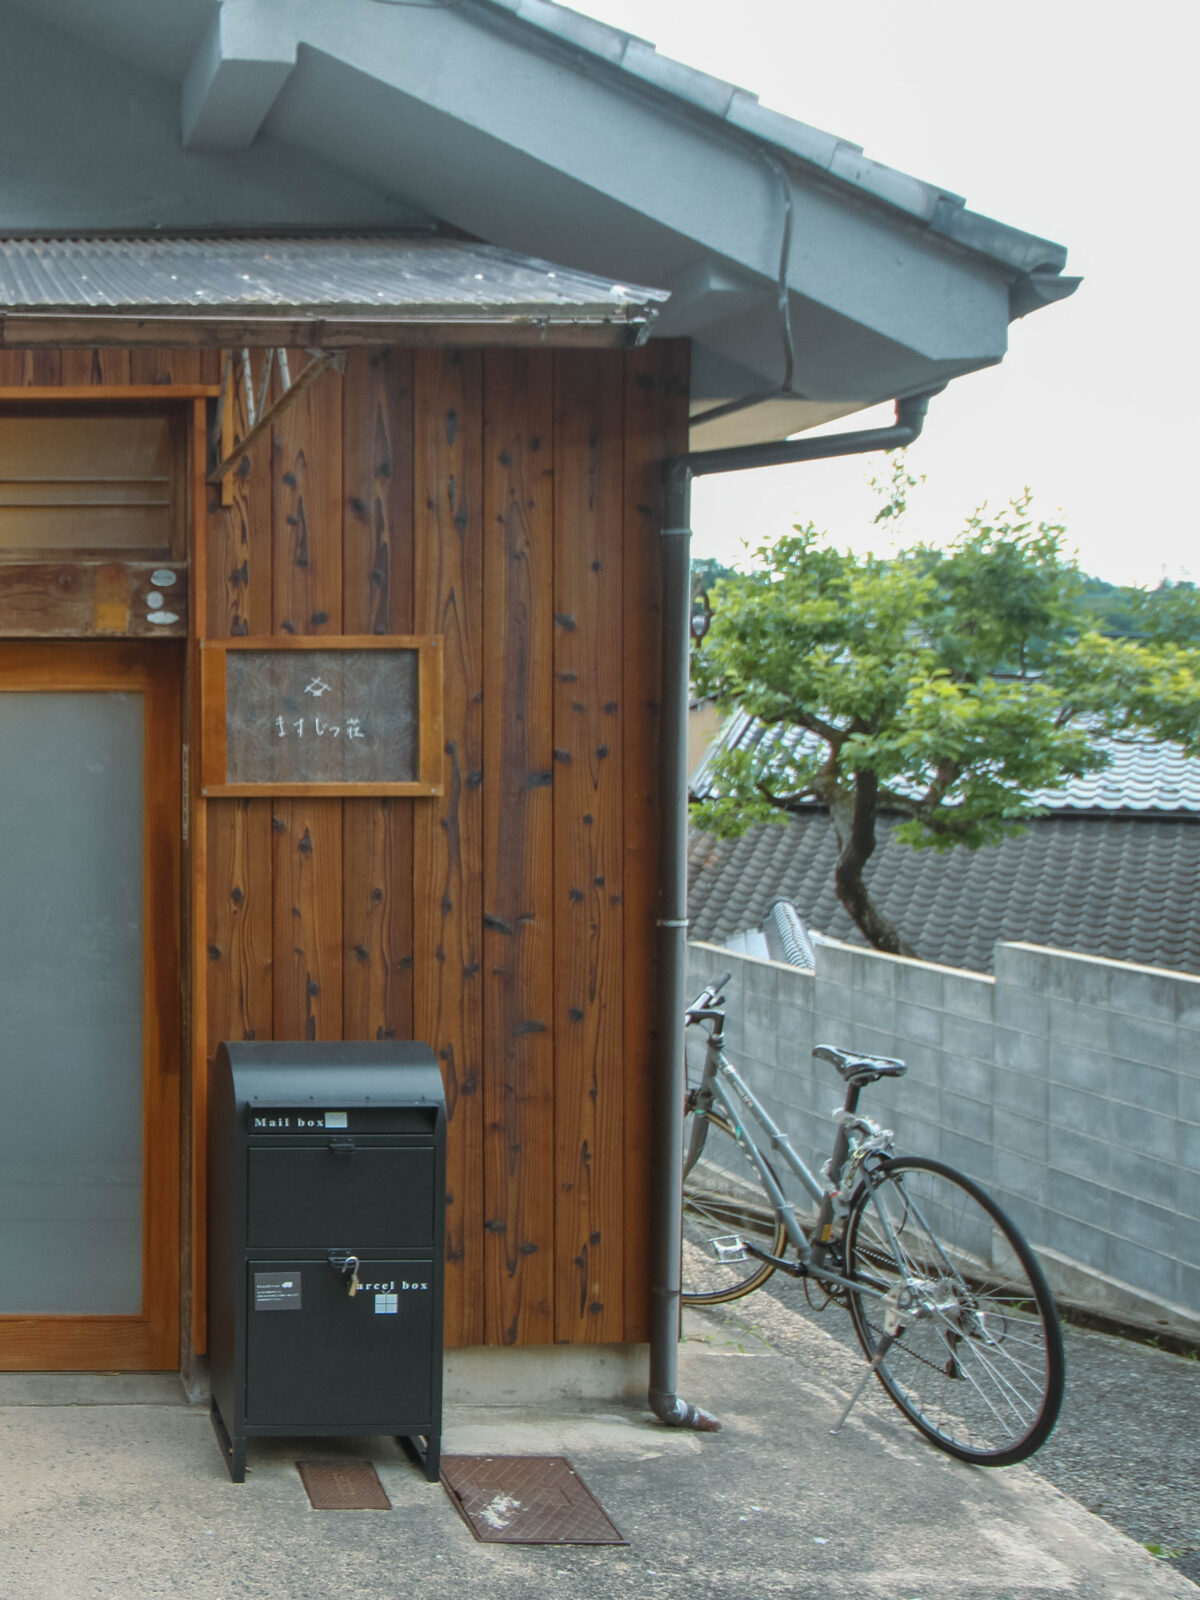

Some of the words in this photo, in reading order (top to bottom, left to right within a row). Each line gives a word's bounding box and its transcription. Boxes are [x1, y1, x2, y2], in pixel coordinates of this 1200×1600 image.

[254, 1117, 290, 1127] Mail
[297, 1117, 324, 1127] box
[356, 1281, 395, 1290] arcel
[402, 1281, 428, 1290] box
